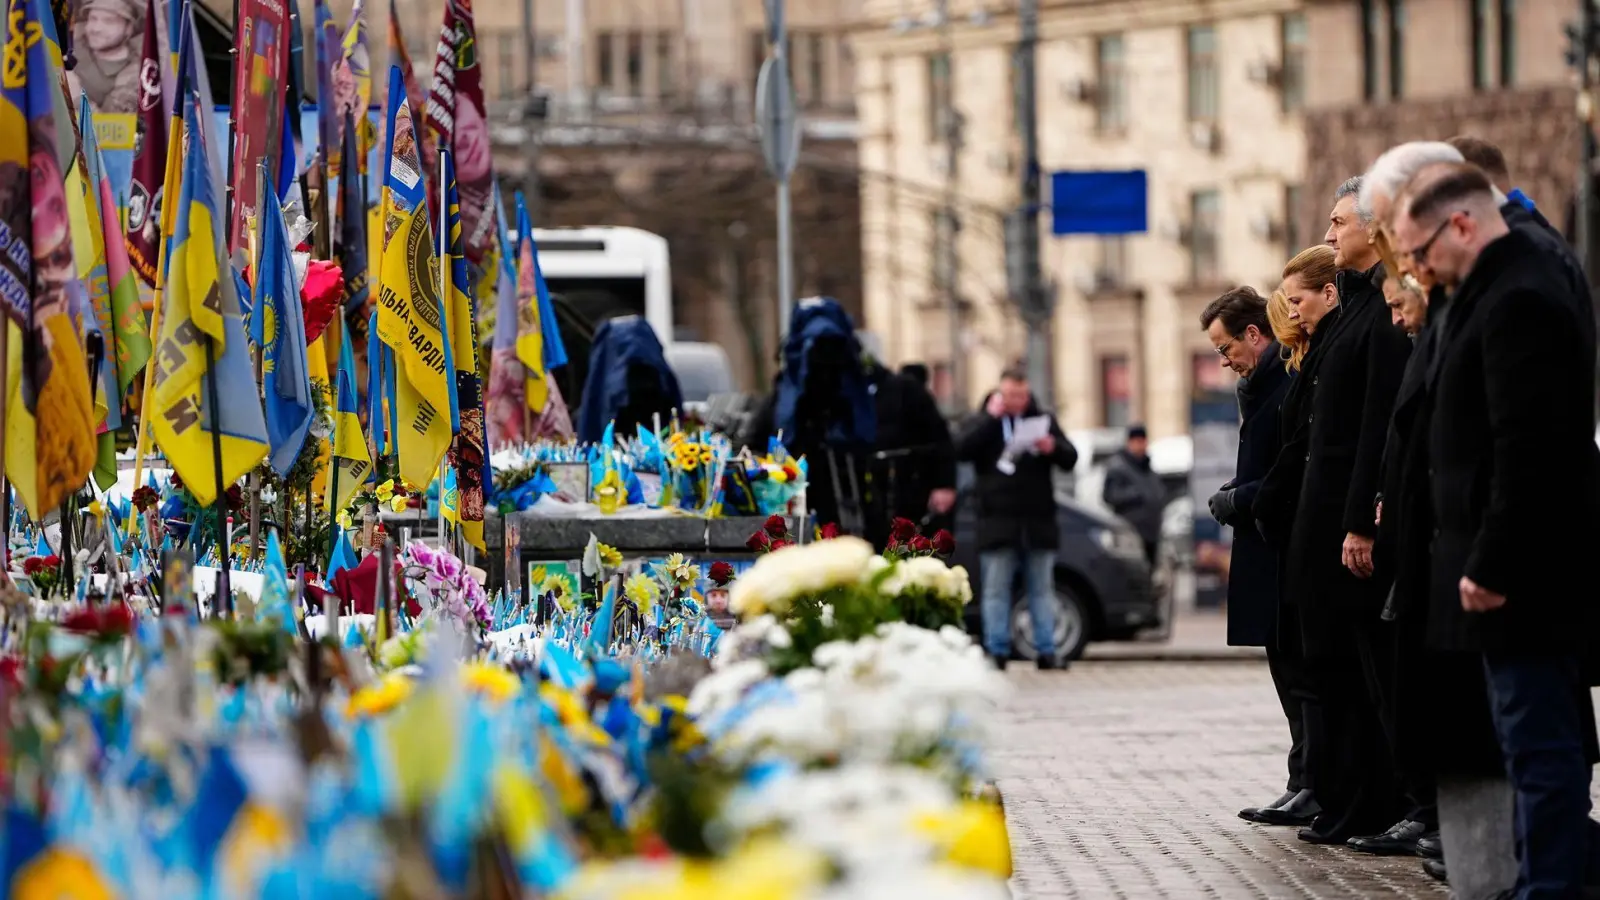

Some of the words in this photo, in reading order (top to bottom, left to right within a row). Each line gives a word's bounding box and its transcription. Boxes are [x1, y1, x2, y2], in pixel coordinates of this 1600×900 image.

[408, 232, 418, 256] ГЕРОЯ
[408, 259, 418, 295] УКРАЇНИ
[413, 295, 442, 329] ЛЕЙТЕНА
